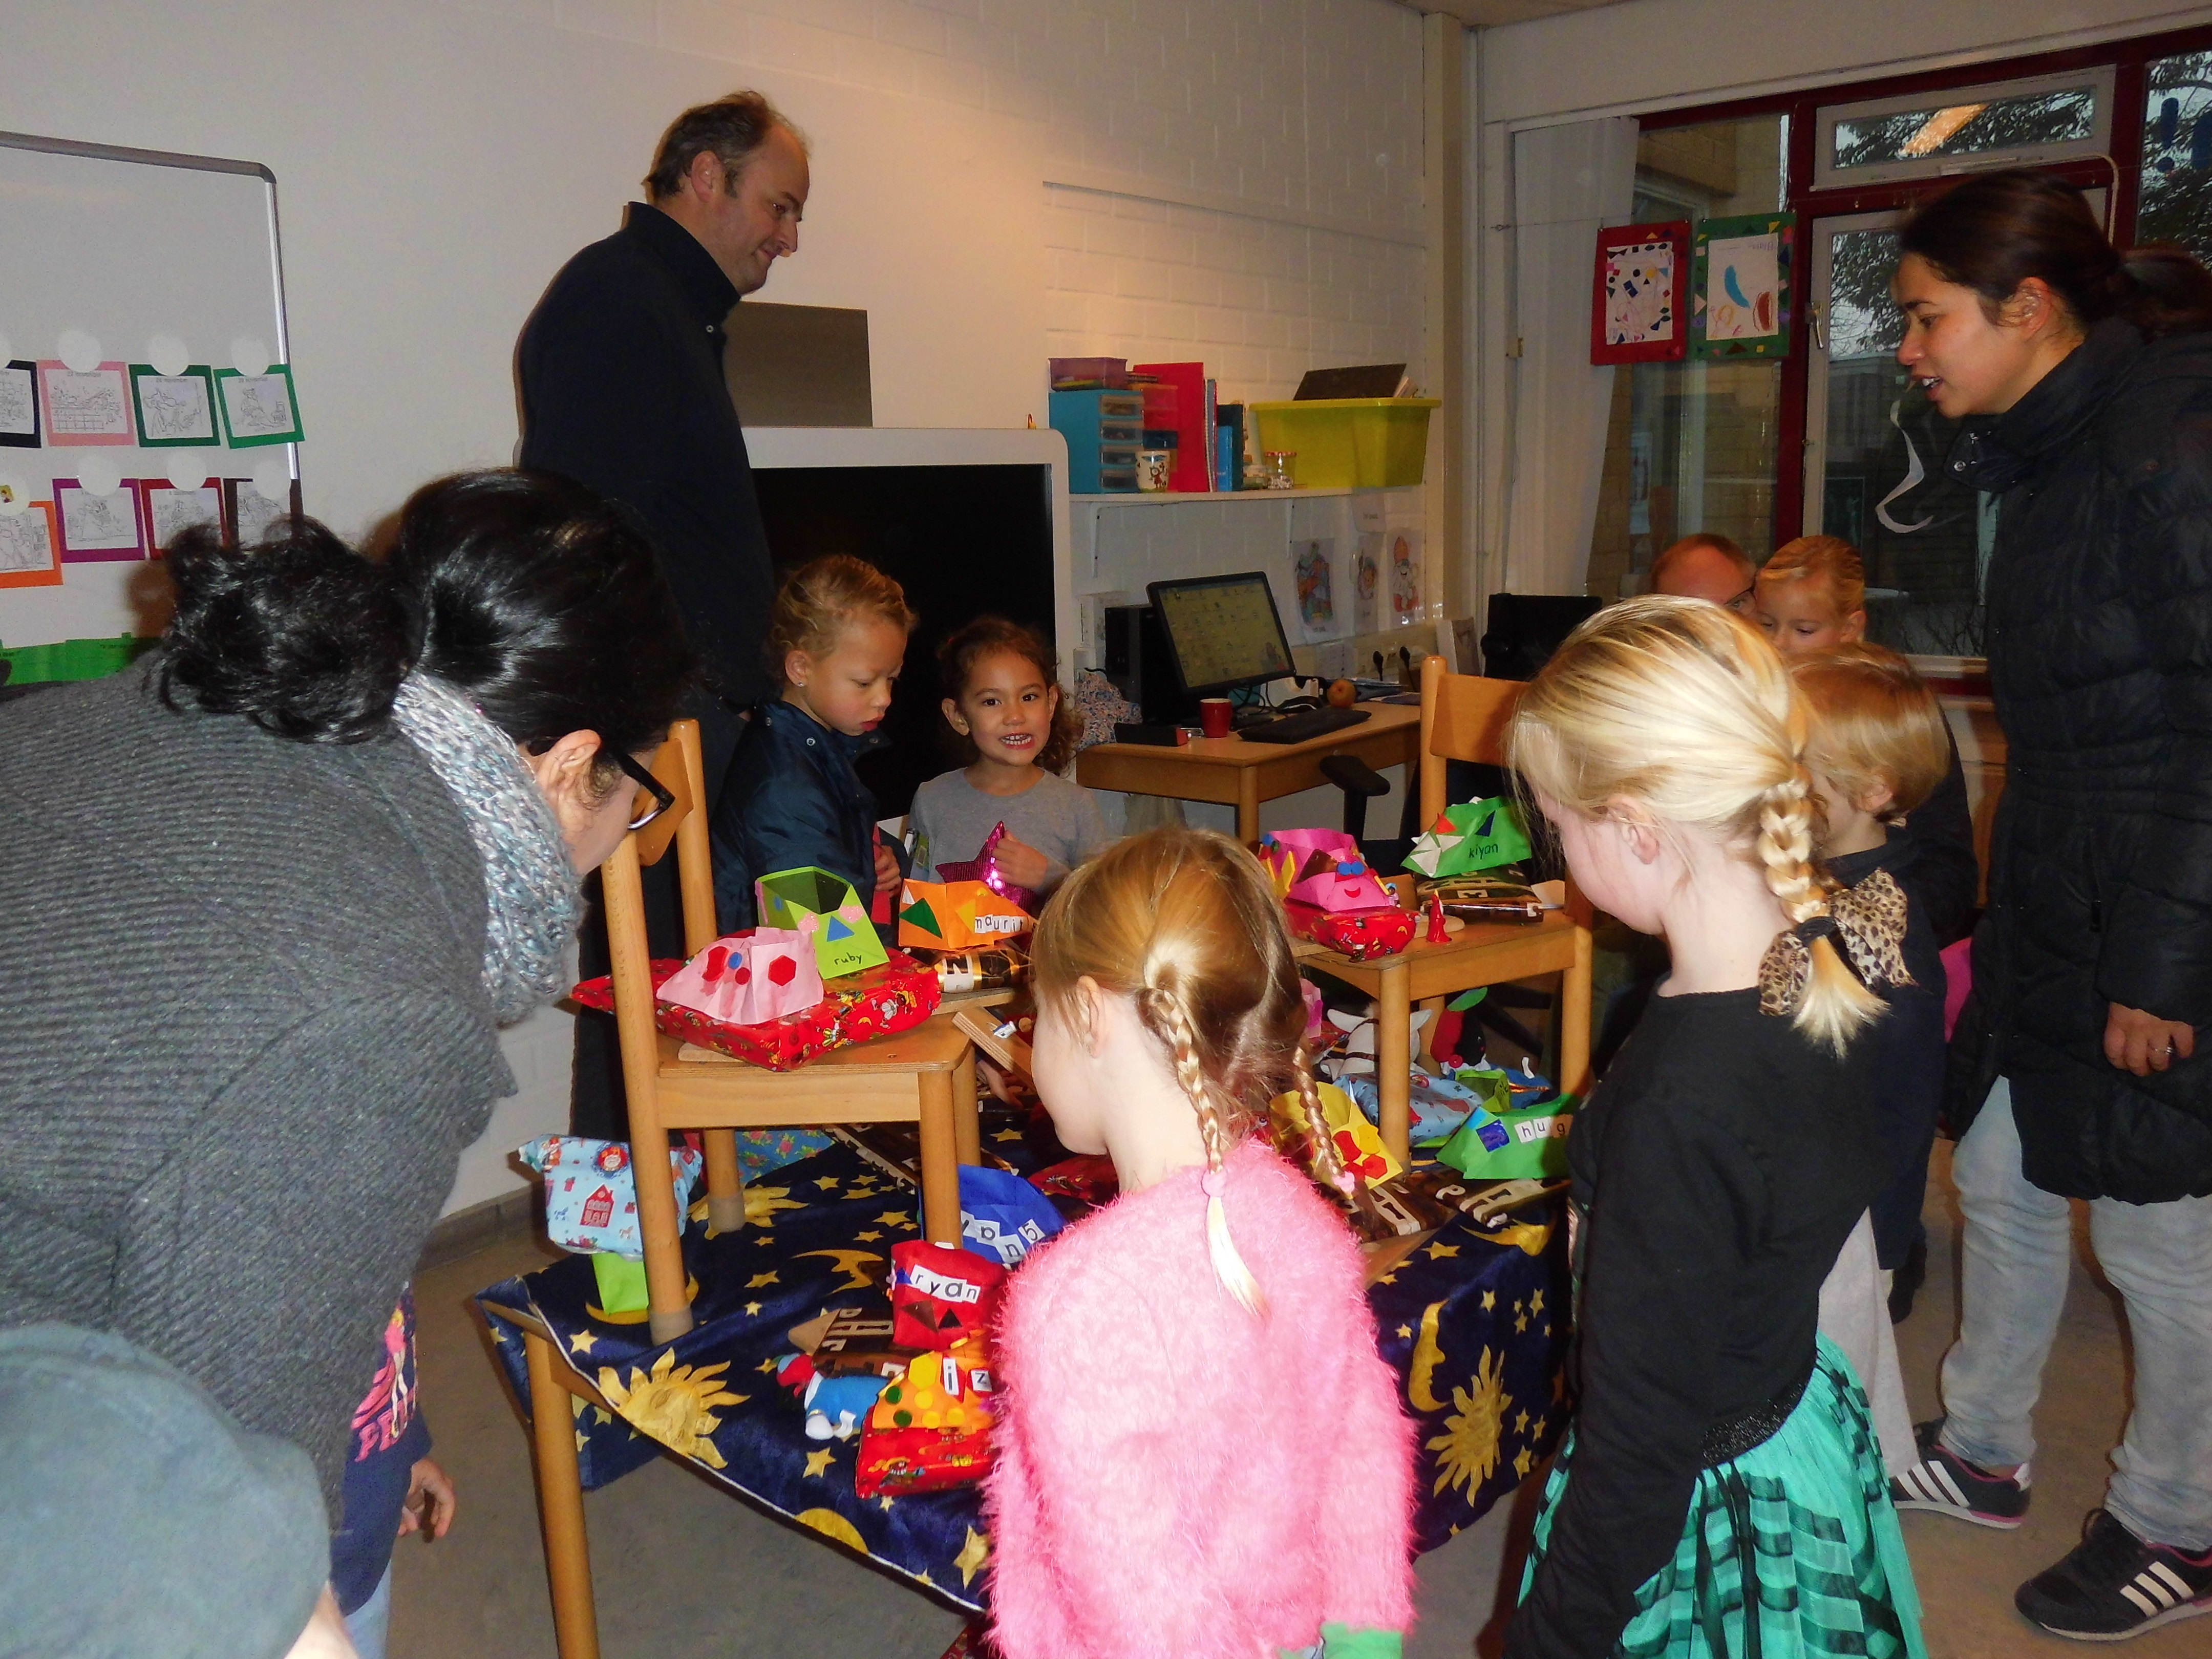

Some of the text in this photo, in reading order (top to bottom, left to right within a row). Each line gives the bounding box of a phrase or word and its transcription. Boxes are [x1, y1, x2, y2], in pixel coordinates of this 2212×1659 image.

[1469, 843, 1499, 859] kiyan
[834, 952, 862, 965] ruby
[915, 1273, 977, 1300] ryan
